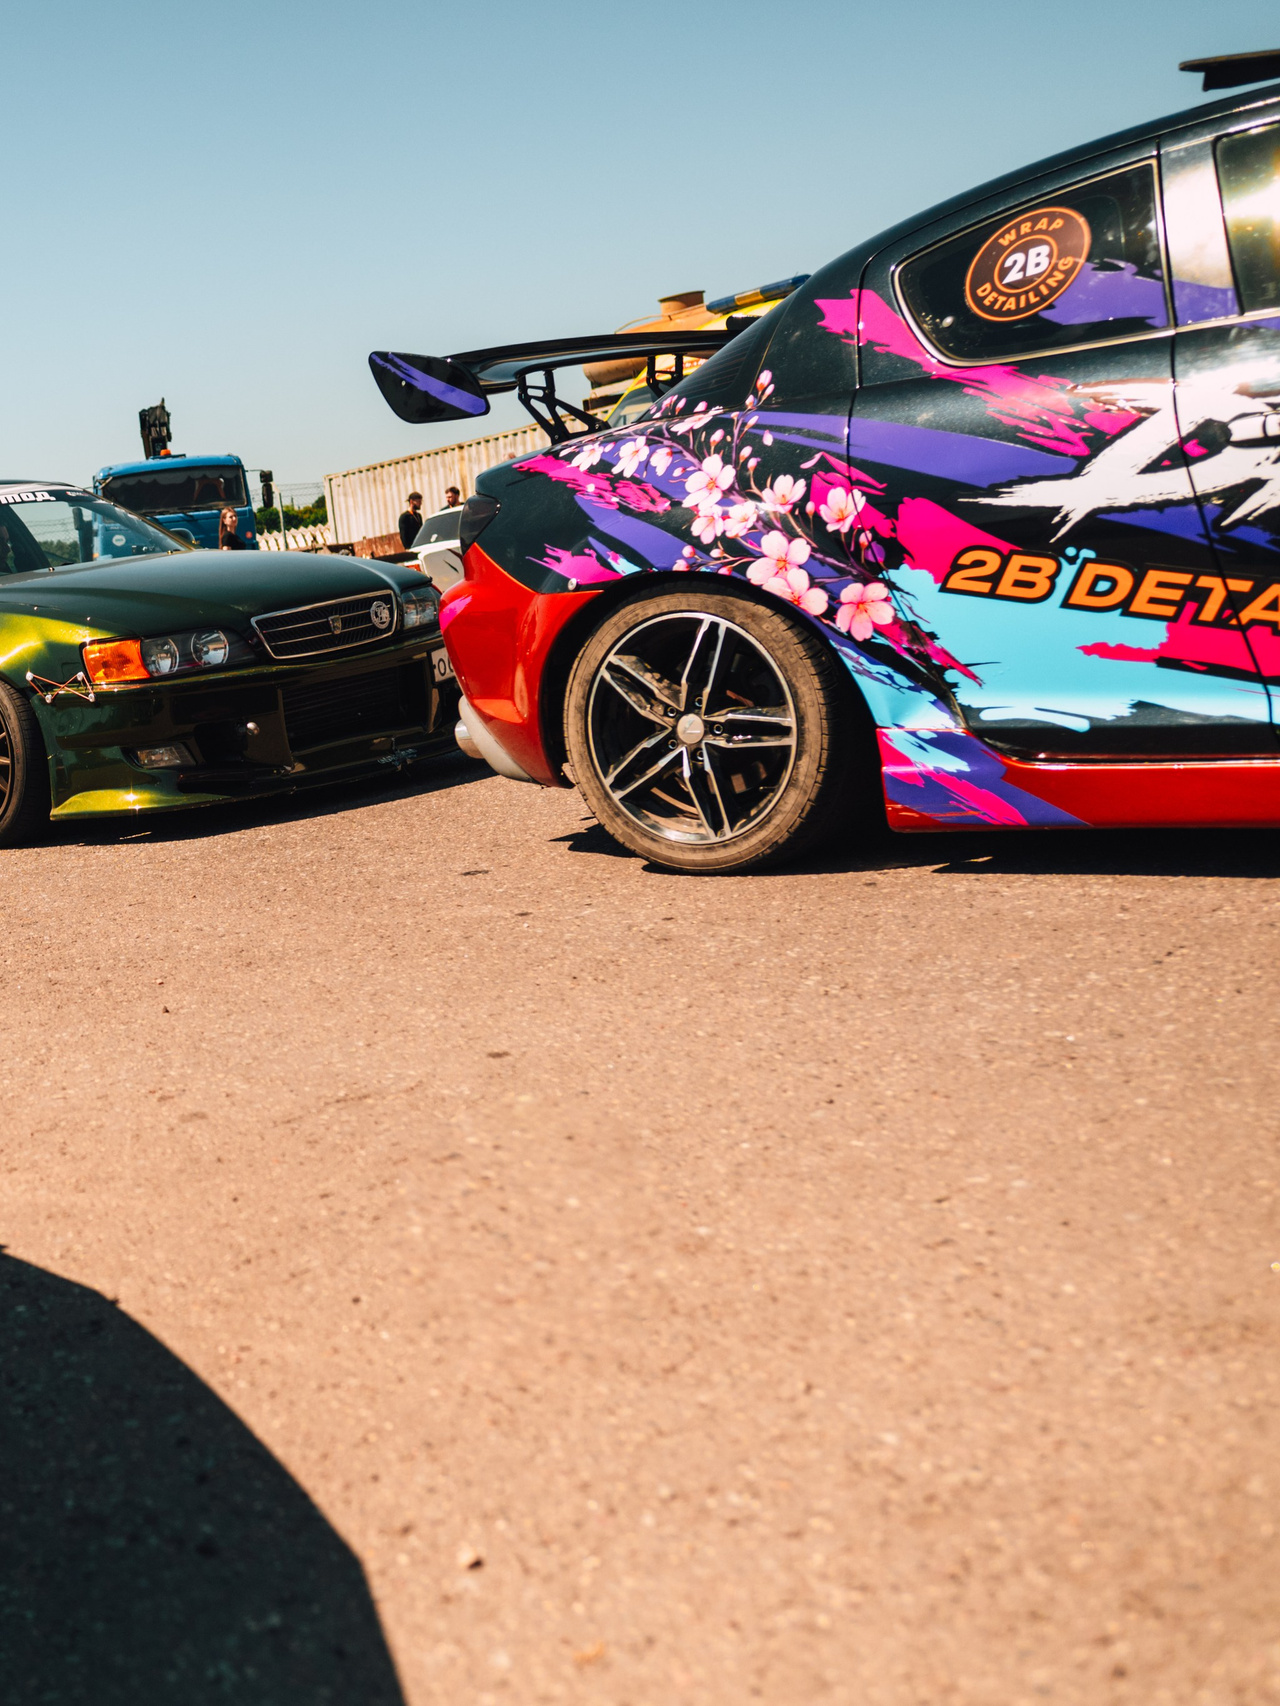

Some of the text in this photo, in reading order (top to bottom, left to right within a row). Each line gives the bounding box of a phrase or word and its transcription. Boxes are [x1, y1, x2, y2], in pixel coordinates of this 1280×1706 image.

[997, 217, 1064, 247] WRAP
[976, 255, 1073, 312] DETAILING
[1001, 244, 1051, 285] 2B
[945, 550, 1057, 599] 2B
